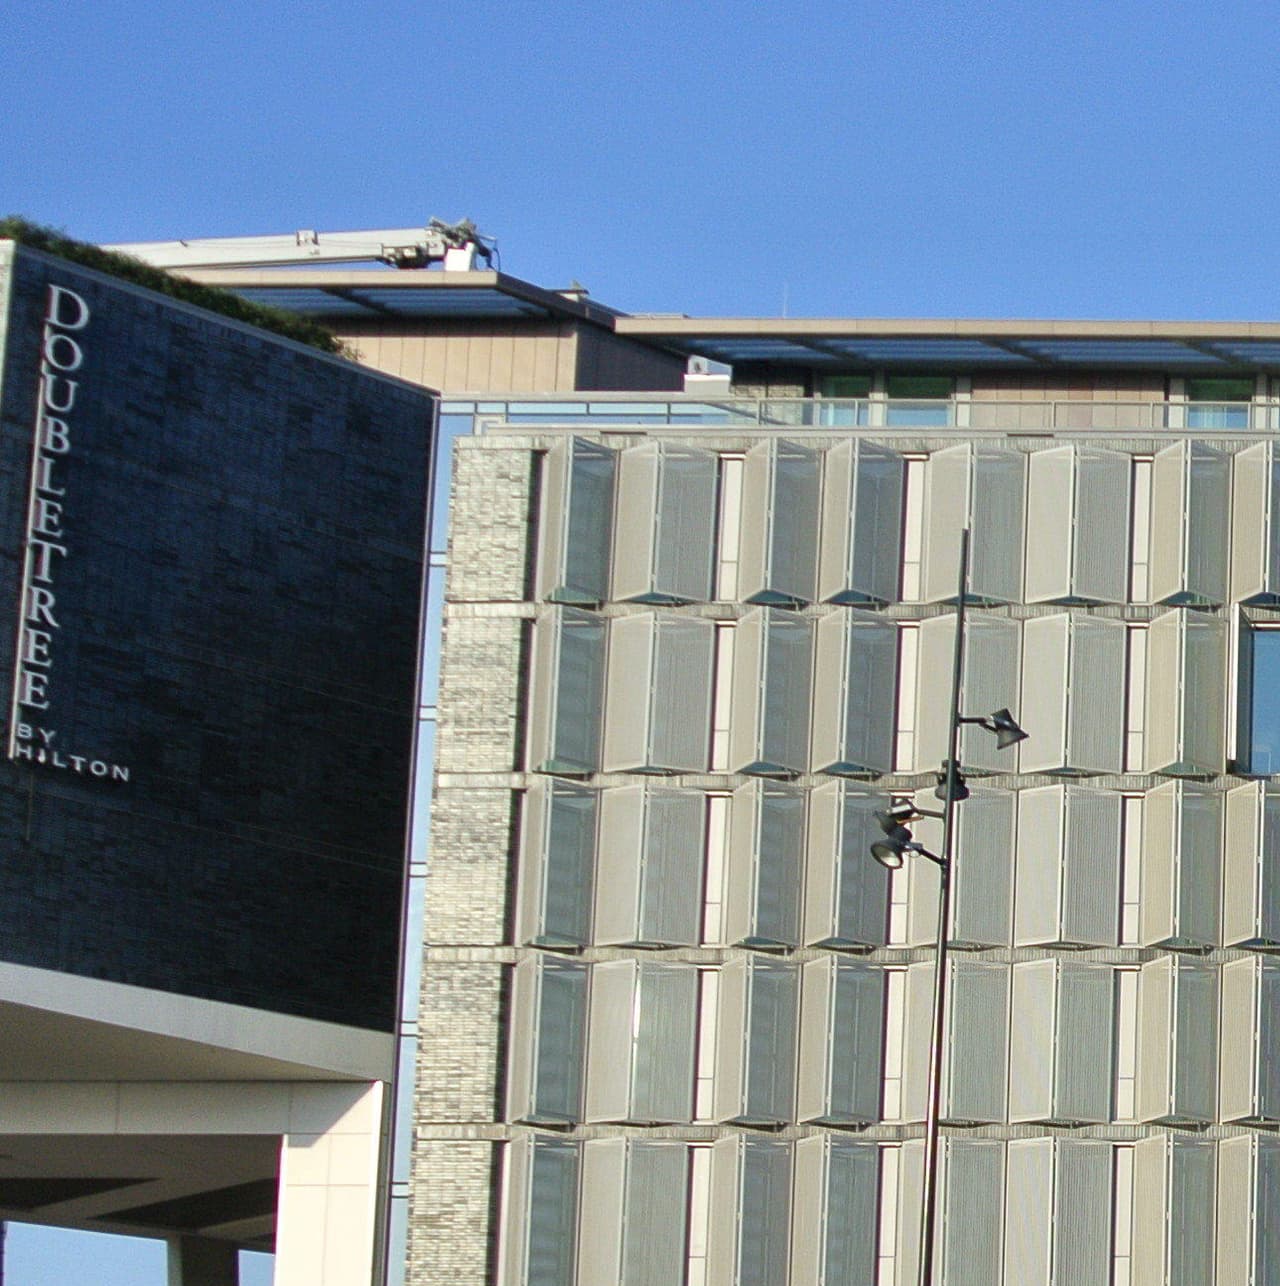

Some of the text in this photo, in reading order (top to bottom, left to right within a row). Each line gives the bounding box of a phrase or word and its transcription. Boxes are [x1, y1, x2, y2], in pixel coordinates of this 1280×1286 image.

[20, 283, 90, 709] DOUBLETREE
[16, 722, 56, 745] BY
[15, 742, 130, 782] HILTON
